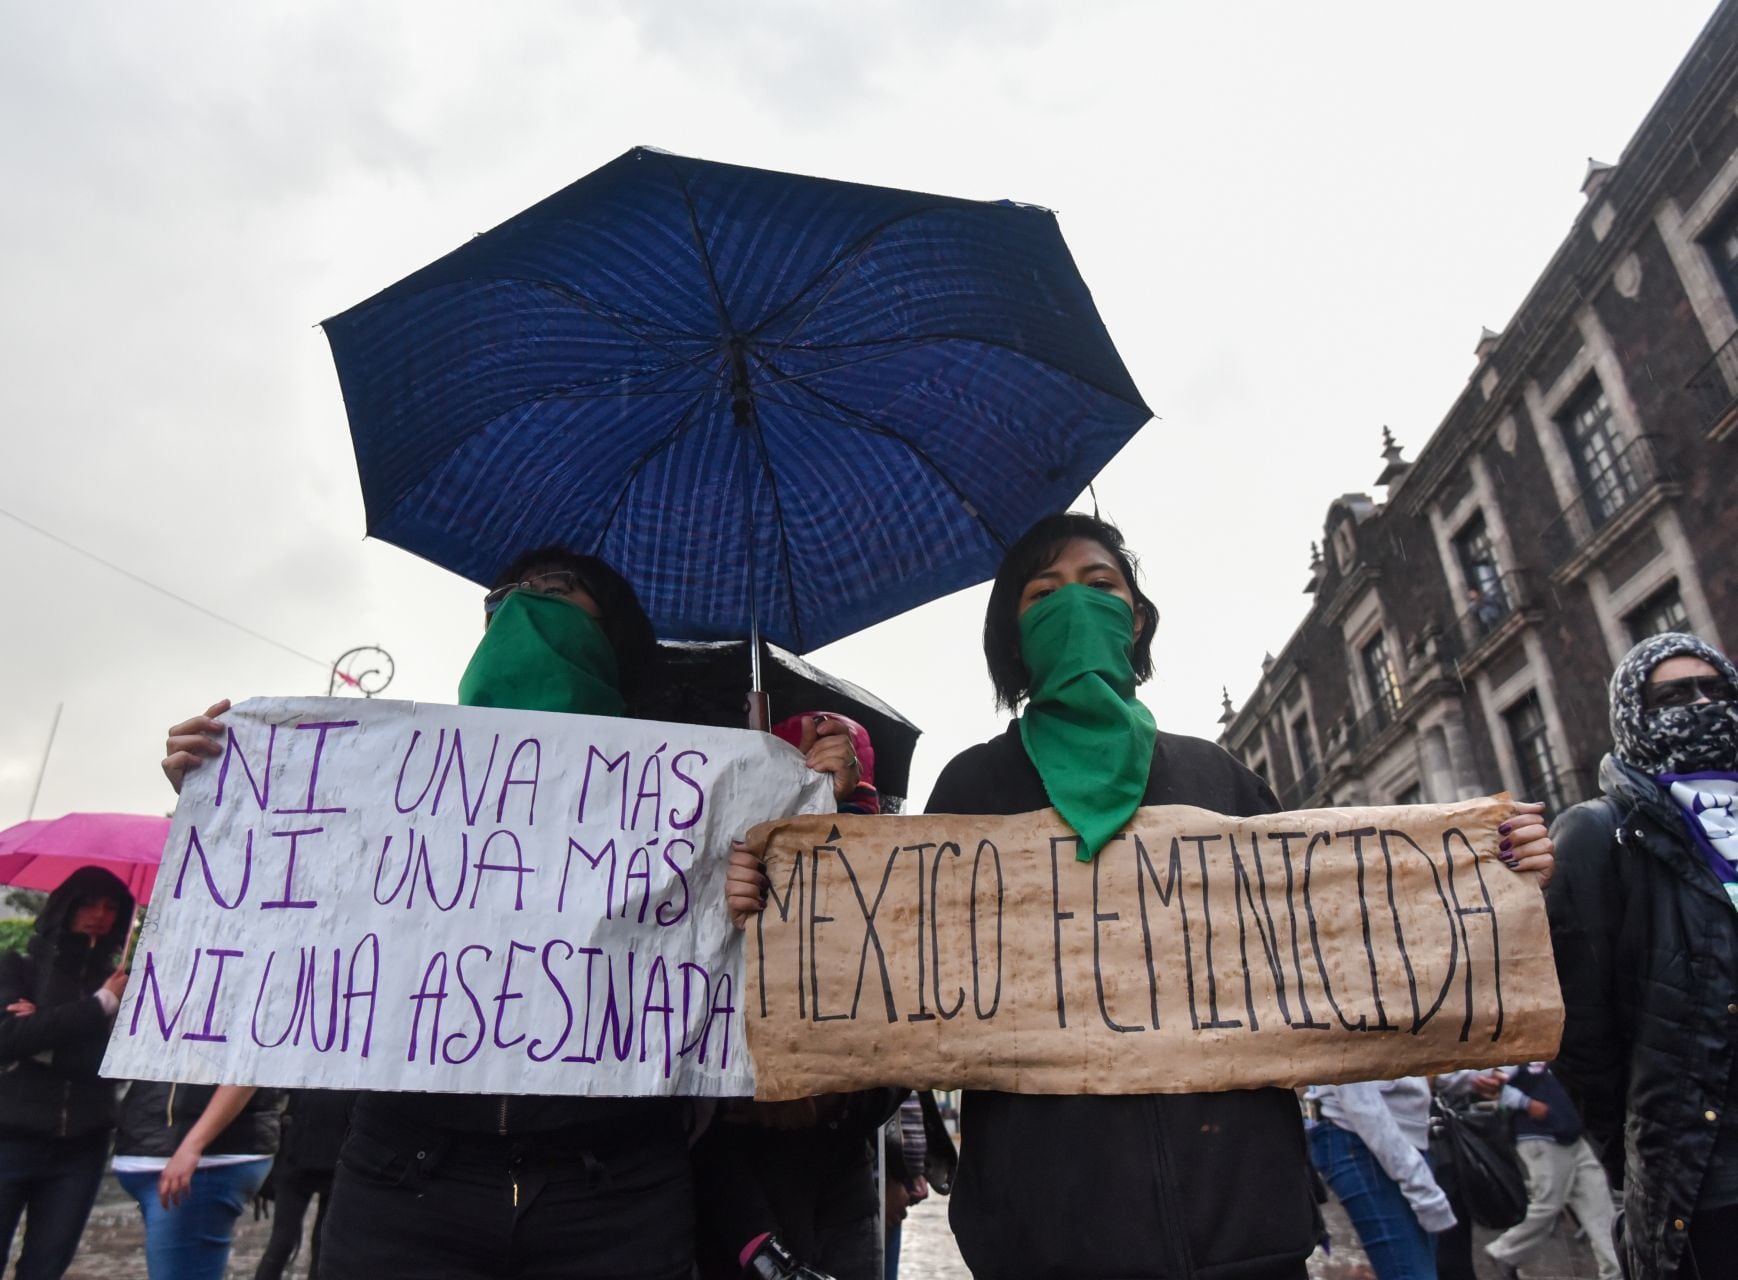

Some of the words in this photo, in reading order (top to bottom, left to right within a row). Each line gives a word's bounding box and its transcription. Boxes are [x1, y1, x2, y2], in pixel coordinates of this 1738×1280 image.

[215, 720, 359, 814] NI
[395, 728, 540, 826] UNA
[579, 743, 708, 830] MÁS
[174, 826, 323, 909] NI
[375, 828, 535, 912] UNA
[558, 837, 694, 926] MÁS
[756, 824, 1003, 1024] MÉXICO
[1050, 827, 1504, 1042] FEMINICIDA
[129, 948, 244, 1041] NI
[251, 933, 379, 1057] UNA
[408, 939, 735, 1078] ASESINADA
